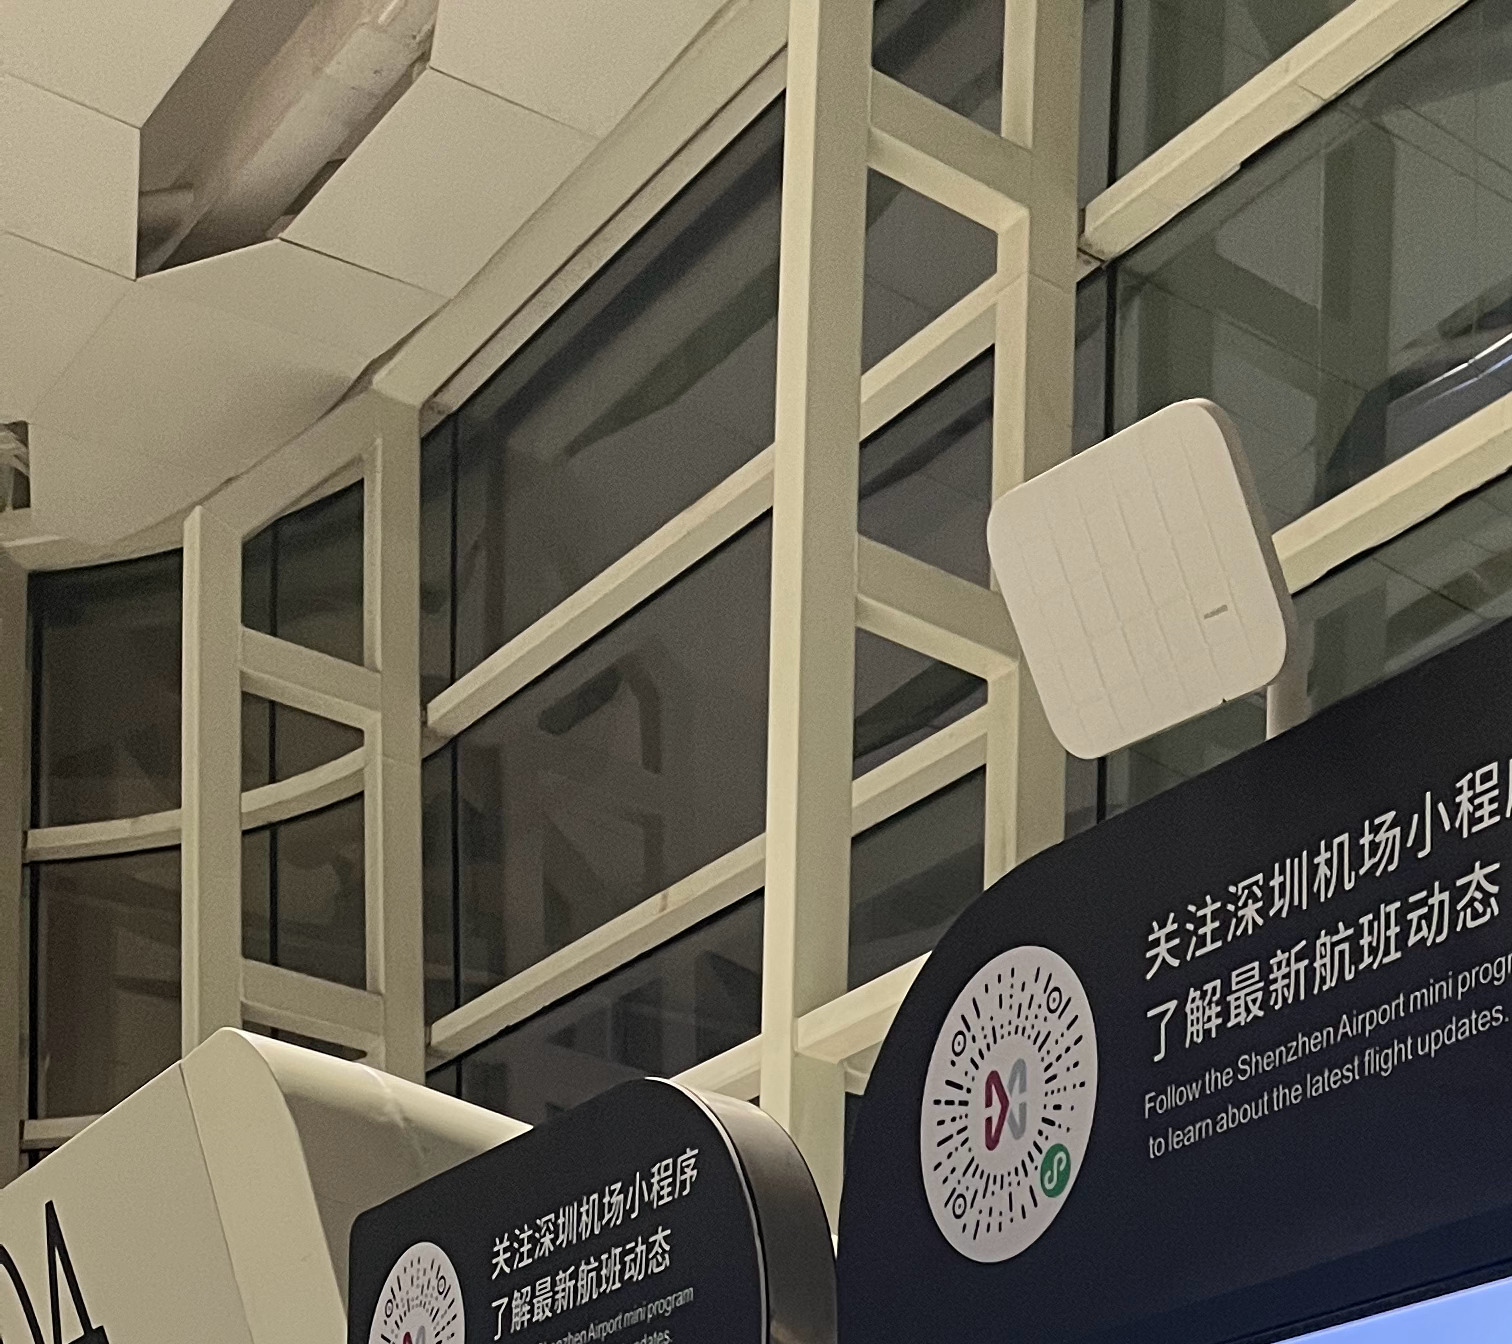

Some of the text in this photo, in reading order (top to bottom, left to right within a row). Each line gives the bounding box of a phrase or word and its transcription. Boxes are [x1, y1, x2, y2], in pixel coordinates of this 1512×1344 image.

[1146, 860, 1501, 1063] 了解最新航班动态
[1144, 1078, 1202, 1119] Follow
[1205, 1066, 1234, 1095] the
[1238, 1026, 1334, 1082] Shenzhen
[1337, 996, 1405, 1042] Airport
[1409, 971, 1453, 1013] mini
[1148, 1004, 1509, 1159] to learn about the latest flight updates.
[491, 1148, 699, 1280] 关注深圳机场小程序
[491, 1226, 671, 1341] 了解最新航班动态
[588, 1313, 622, 1342] Airport
[623, 1301, 647, 1330] mini
[647, 1287, 694, 1323] program
